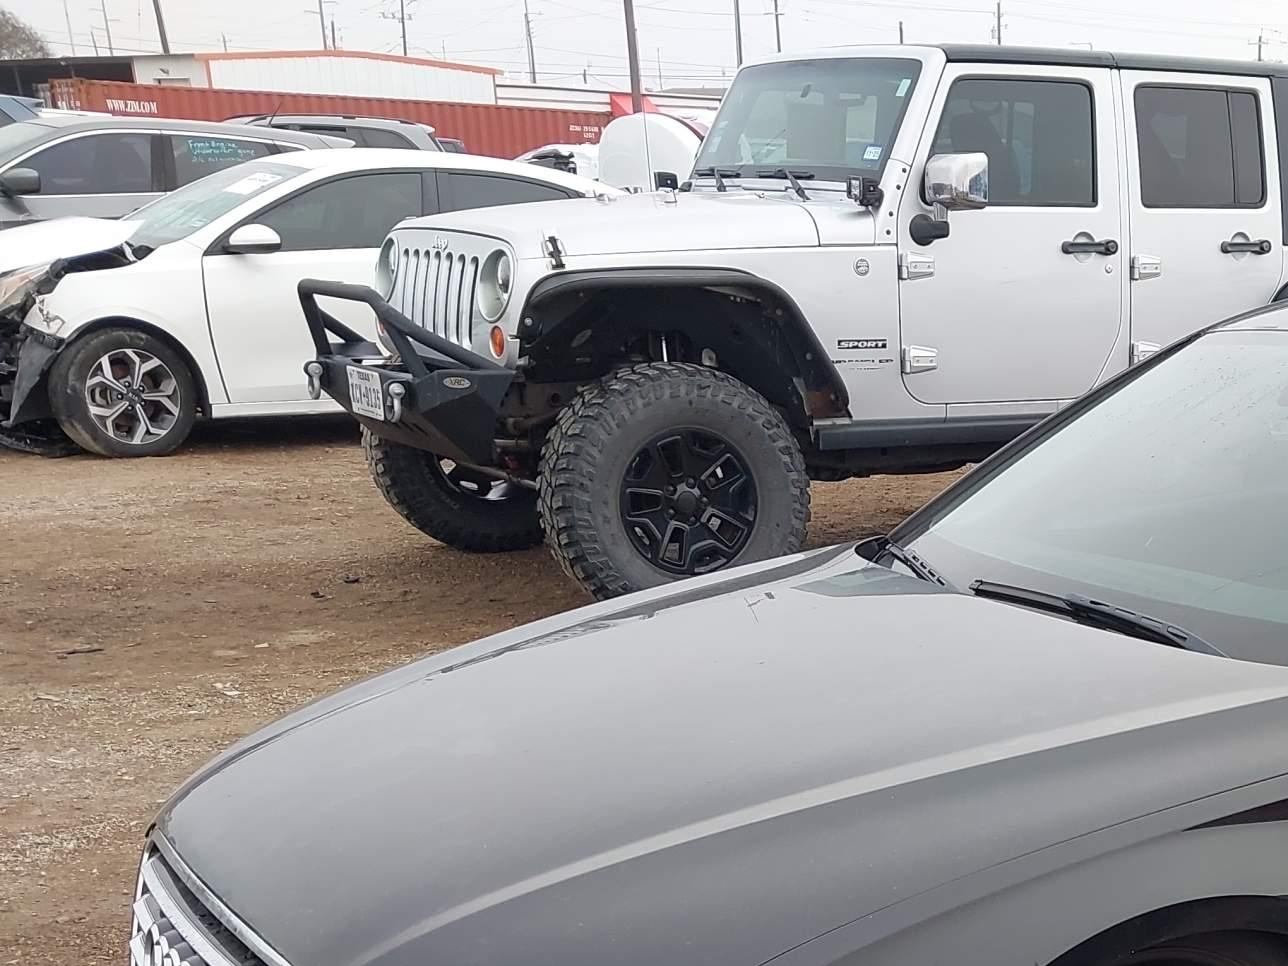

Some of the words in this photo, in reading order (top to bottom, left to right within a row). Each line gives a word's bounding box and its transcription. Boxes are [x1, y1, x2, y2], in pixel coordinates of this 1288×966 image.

[105, 99, 158, 114] WWW.ZIM.COM
[839, 340, 887, 348] SPORT
[356, 370, 370, 382] TEXAS
